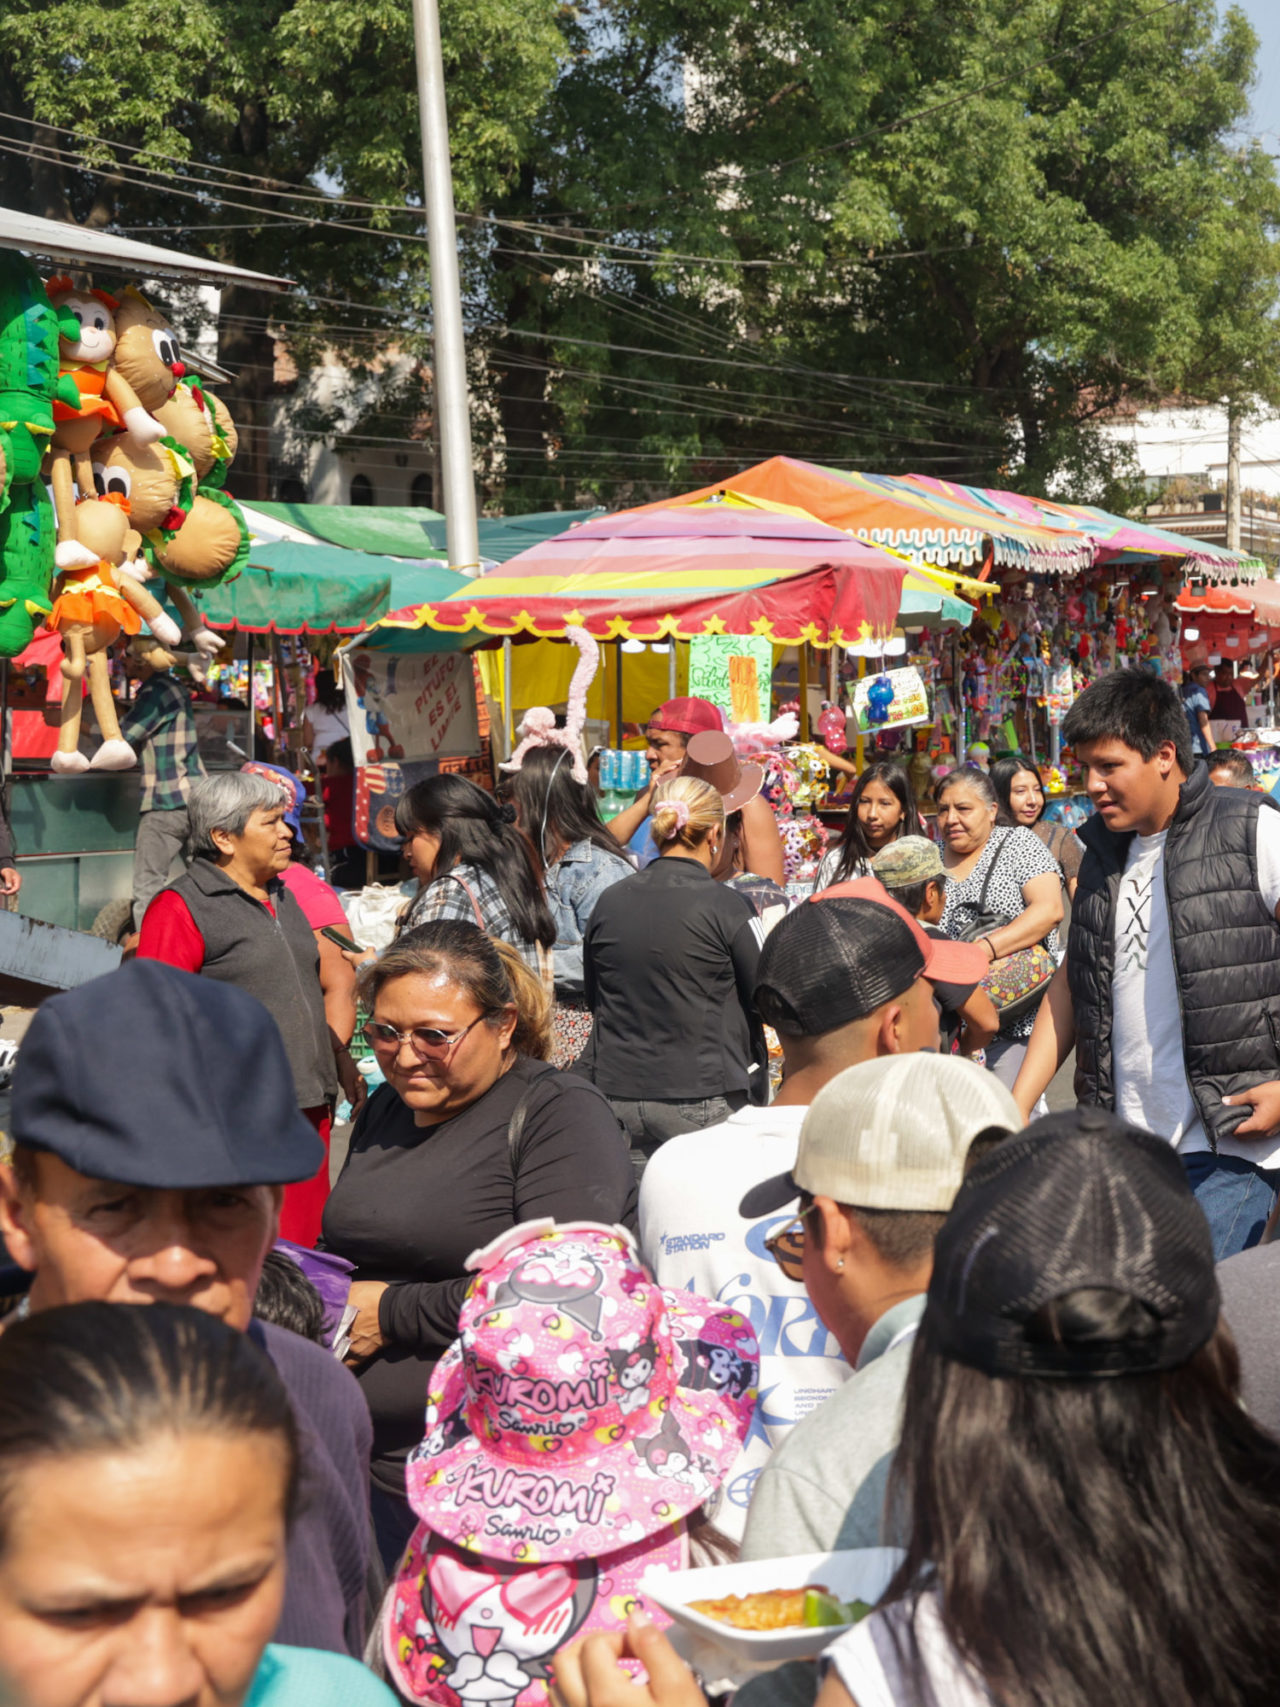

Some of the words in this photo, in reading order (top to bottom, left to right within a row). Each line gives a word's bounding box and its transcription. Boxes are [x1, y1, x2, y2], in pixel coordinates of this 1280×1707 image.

[665, 1232, 726, 1247] STANDARD
[665, 1240, 711, 1255] STATION
[471, 1359, 610, 1416] KUROMI
[497, 1410, 576, 1437] Sanrio
[454, 1463, 617, 1526] KUROMI
[484, 1513, 561, 1546] Sanrio
